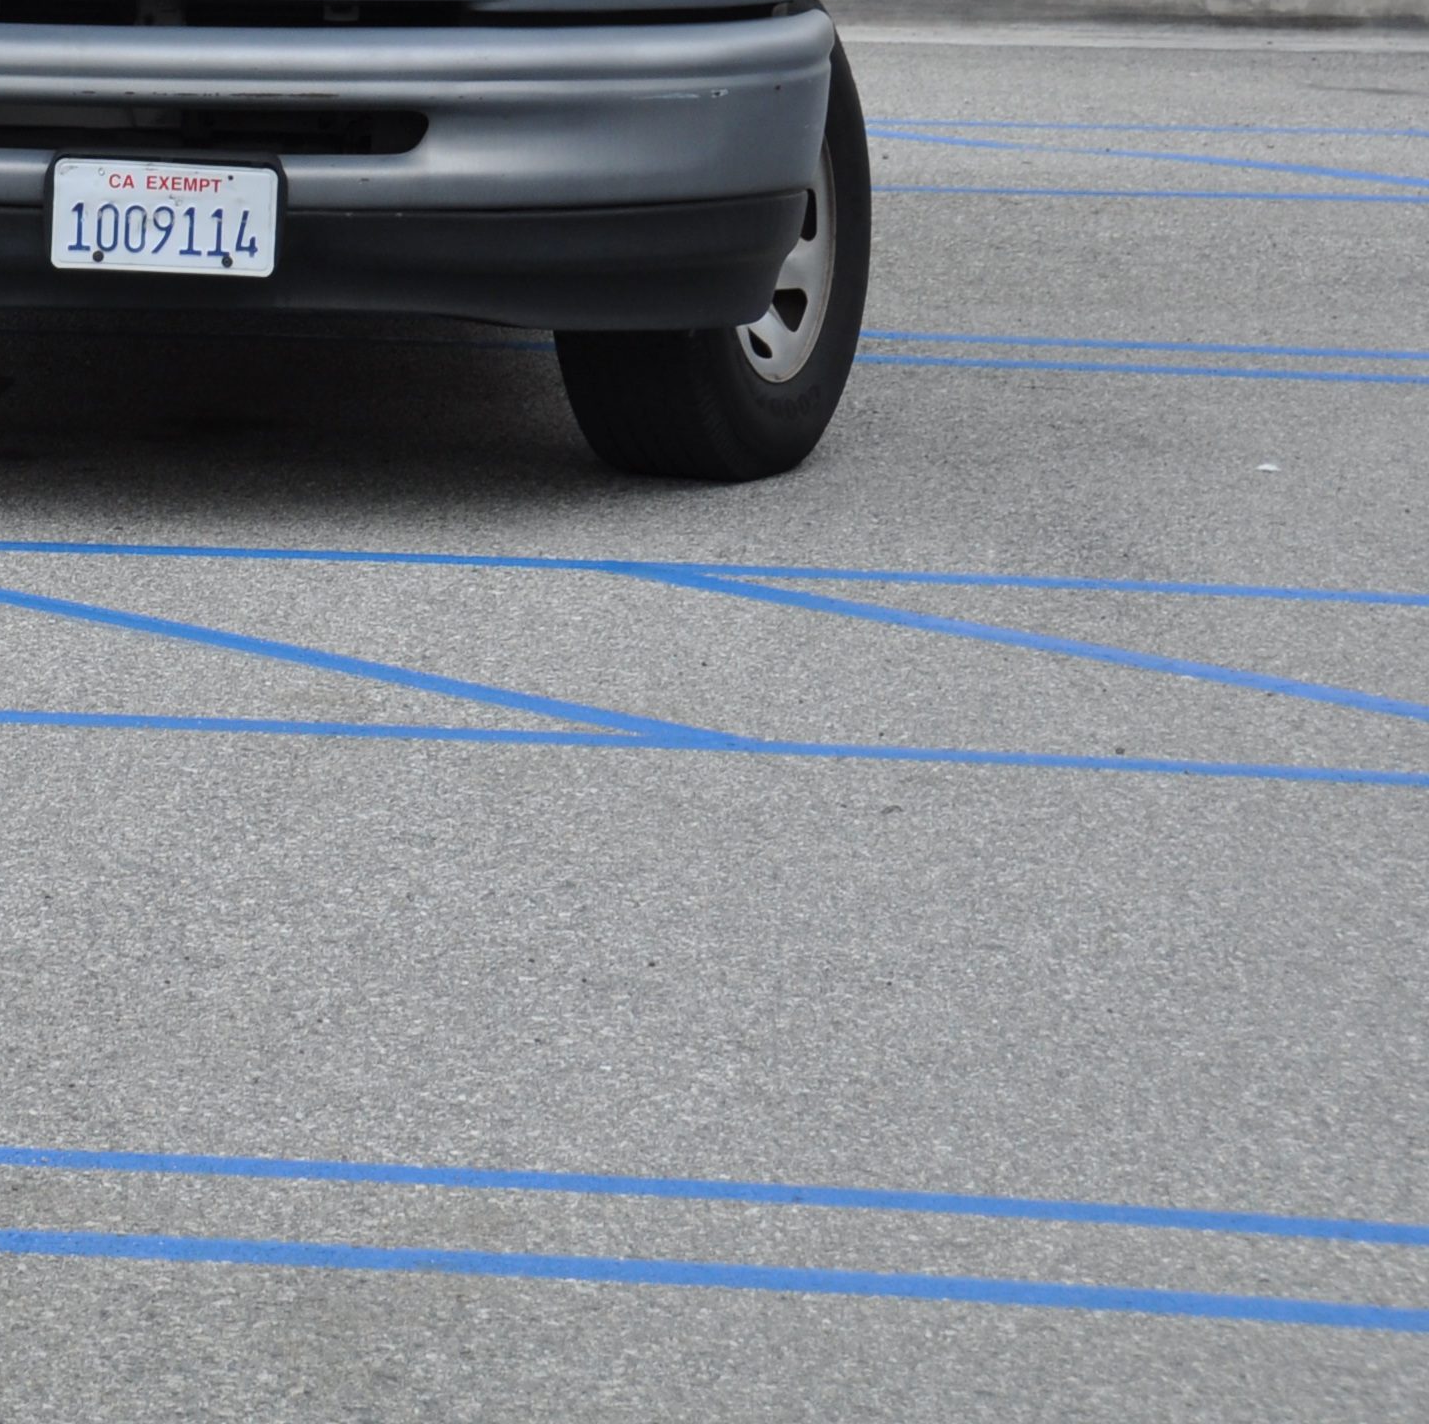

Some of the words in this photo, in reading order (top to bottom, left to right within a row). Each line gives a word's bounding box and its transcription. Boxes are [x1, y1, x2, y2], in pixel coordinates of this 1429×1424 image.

[108, 173, 135, 189] CA
[146, 175, 223, 193] EXEMPT
[67, 202, 259, 258] 1009114
